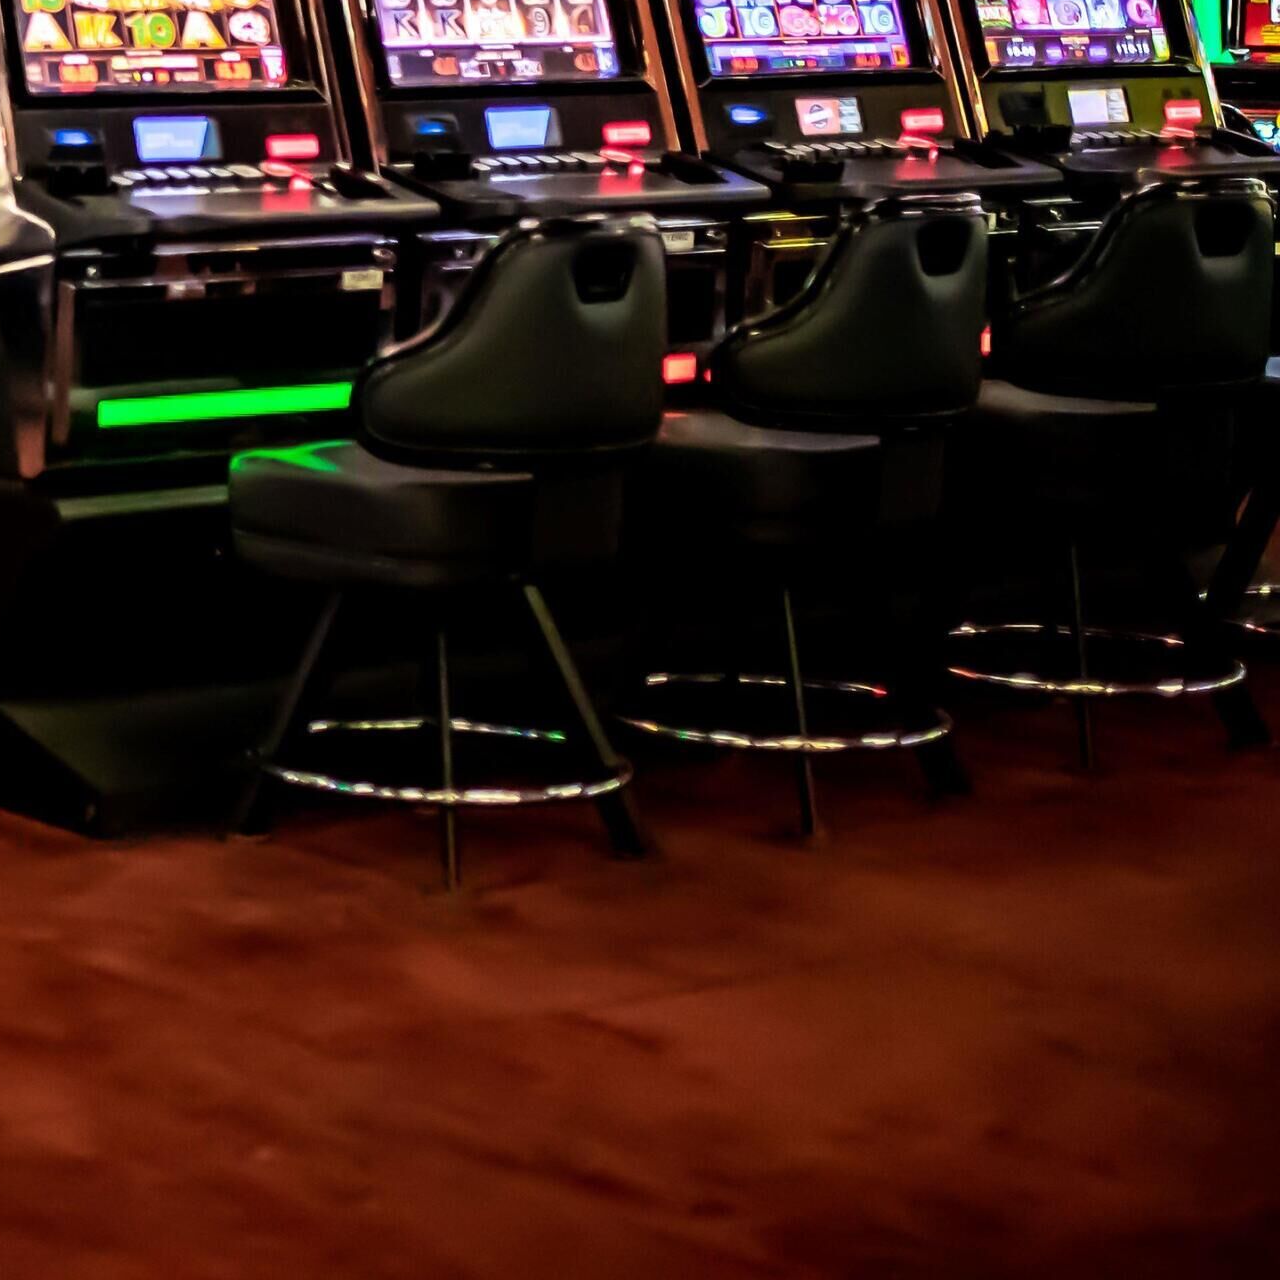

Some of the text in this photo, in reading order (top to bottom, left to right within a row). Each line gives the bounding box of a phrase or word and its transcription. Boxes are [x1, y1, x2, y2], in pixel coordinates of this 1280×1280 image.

[24, 11, 270, 49] A K 10 A Q
[391, 10, 420, 40] K
[437, 10, 466, 40] K
[531, 8, 551, 35] 9
